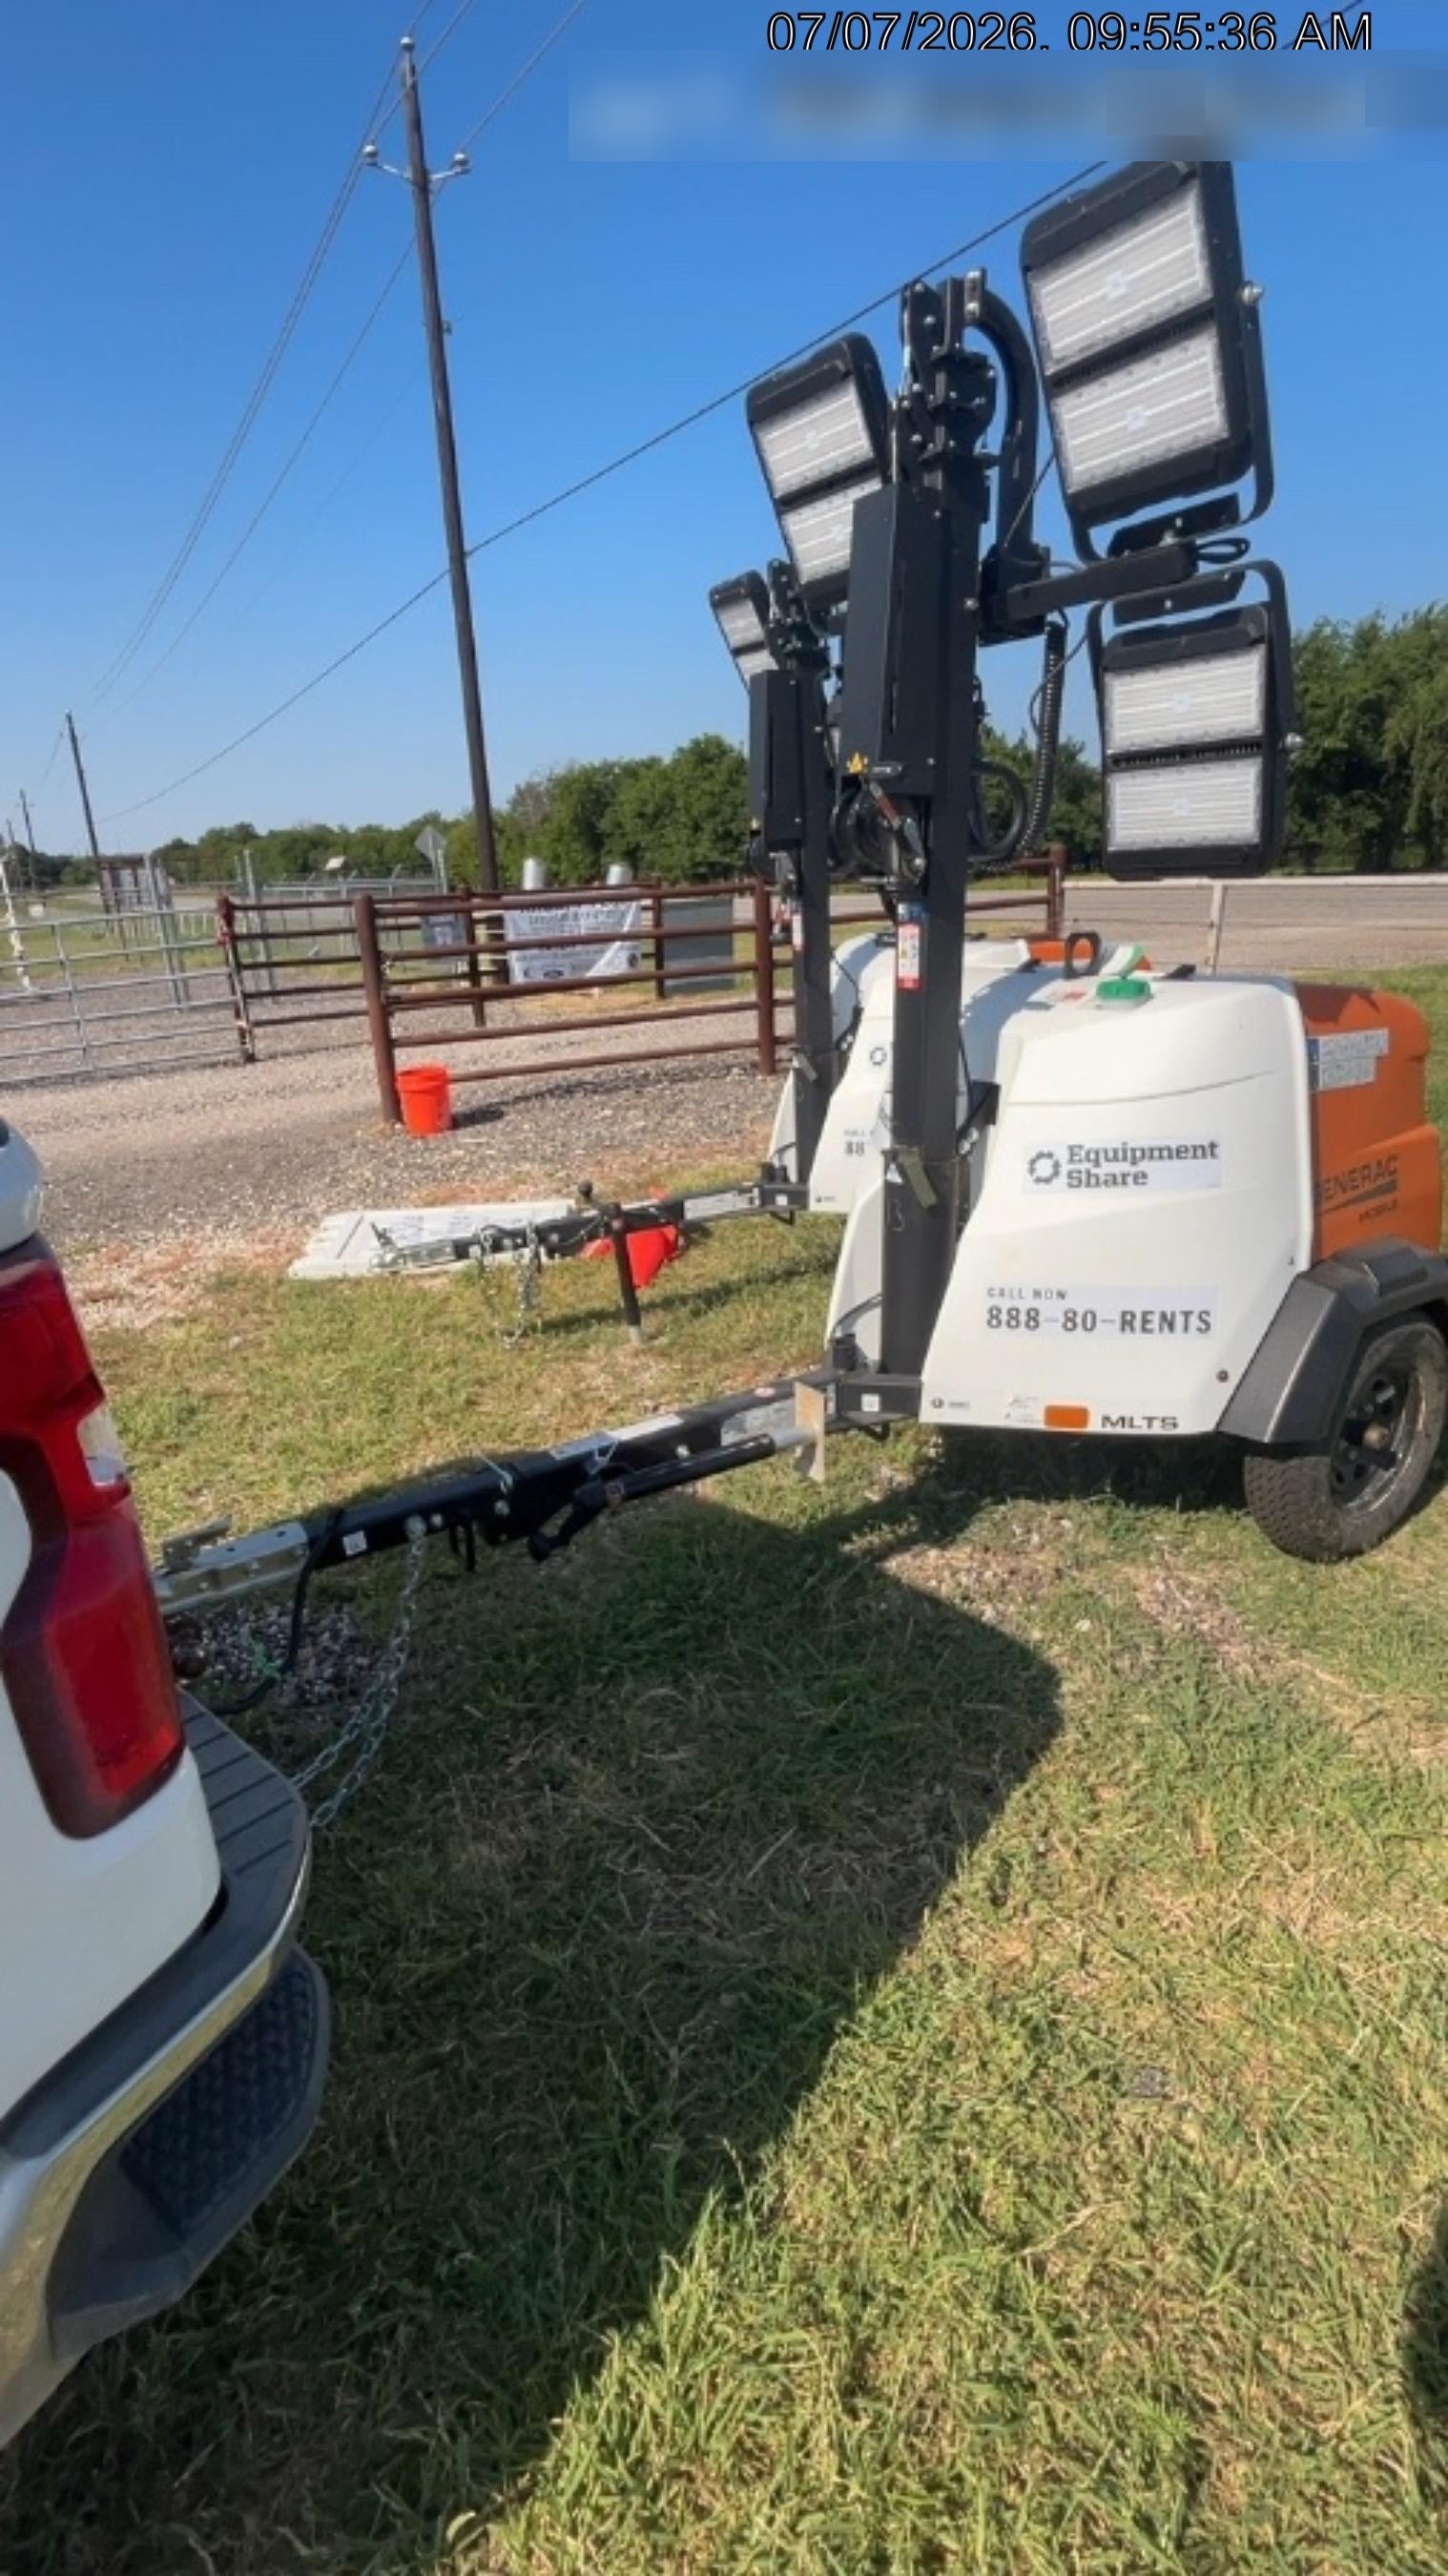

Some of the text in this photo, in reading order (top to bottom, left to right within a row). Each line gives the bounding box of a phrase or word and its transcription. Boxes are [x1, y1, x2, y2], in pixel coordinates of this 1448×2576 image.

[1066, 1141, 1220, 1168] Equipment
[1066, 1168, 1148, 1189] Share
[1316, 1153, 1397, 1202] ENERAC
[986, 1286, 1067, 1300] CALL NOW
[985, 1304, 1212, 1335] 888-80-RENTS
[1101, 1415, 1179, 1430] MLTS
